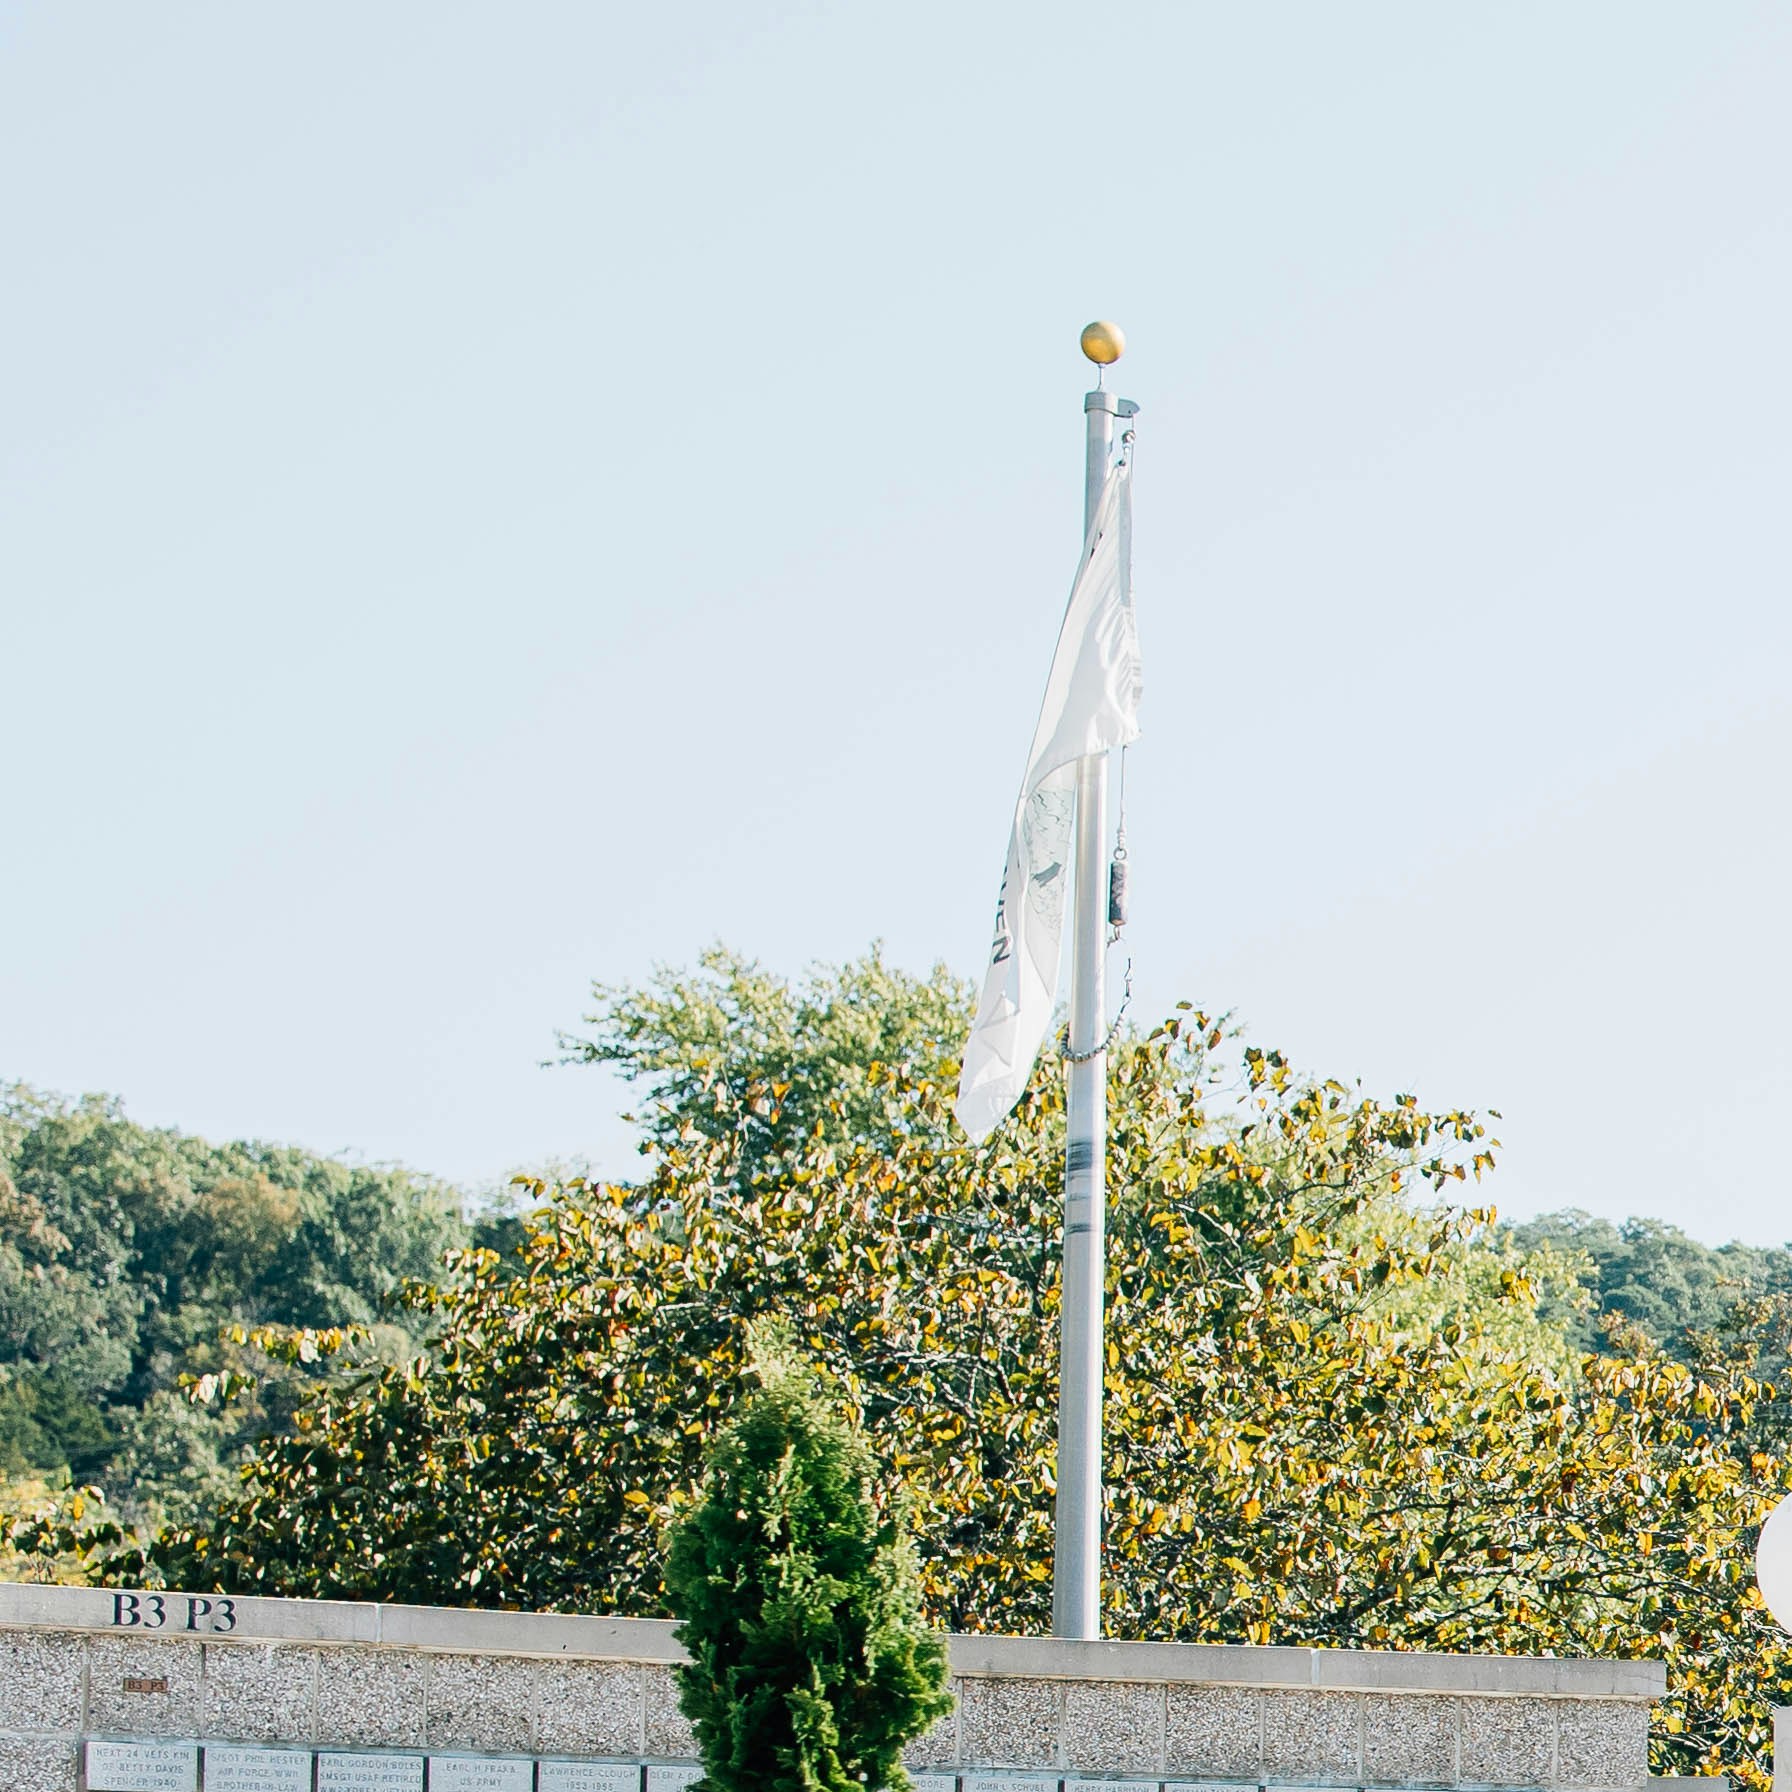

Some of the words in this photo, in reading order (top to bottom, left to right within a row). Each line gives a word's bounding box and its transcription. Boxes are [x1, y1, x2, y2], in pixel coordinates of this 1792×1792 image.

[111, 1593, 166, 1629] B3
[186, 1598, 237, 1632] P3
[128, 1682, 143, 1690] B3
[151, 1683, 164, 1691] P3
